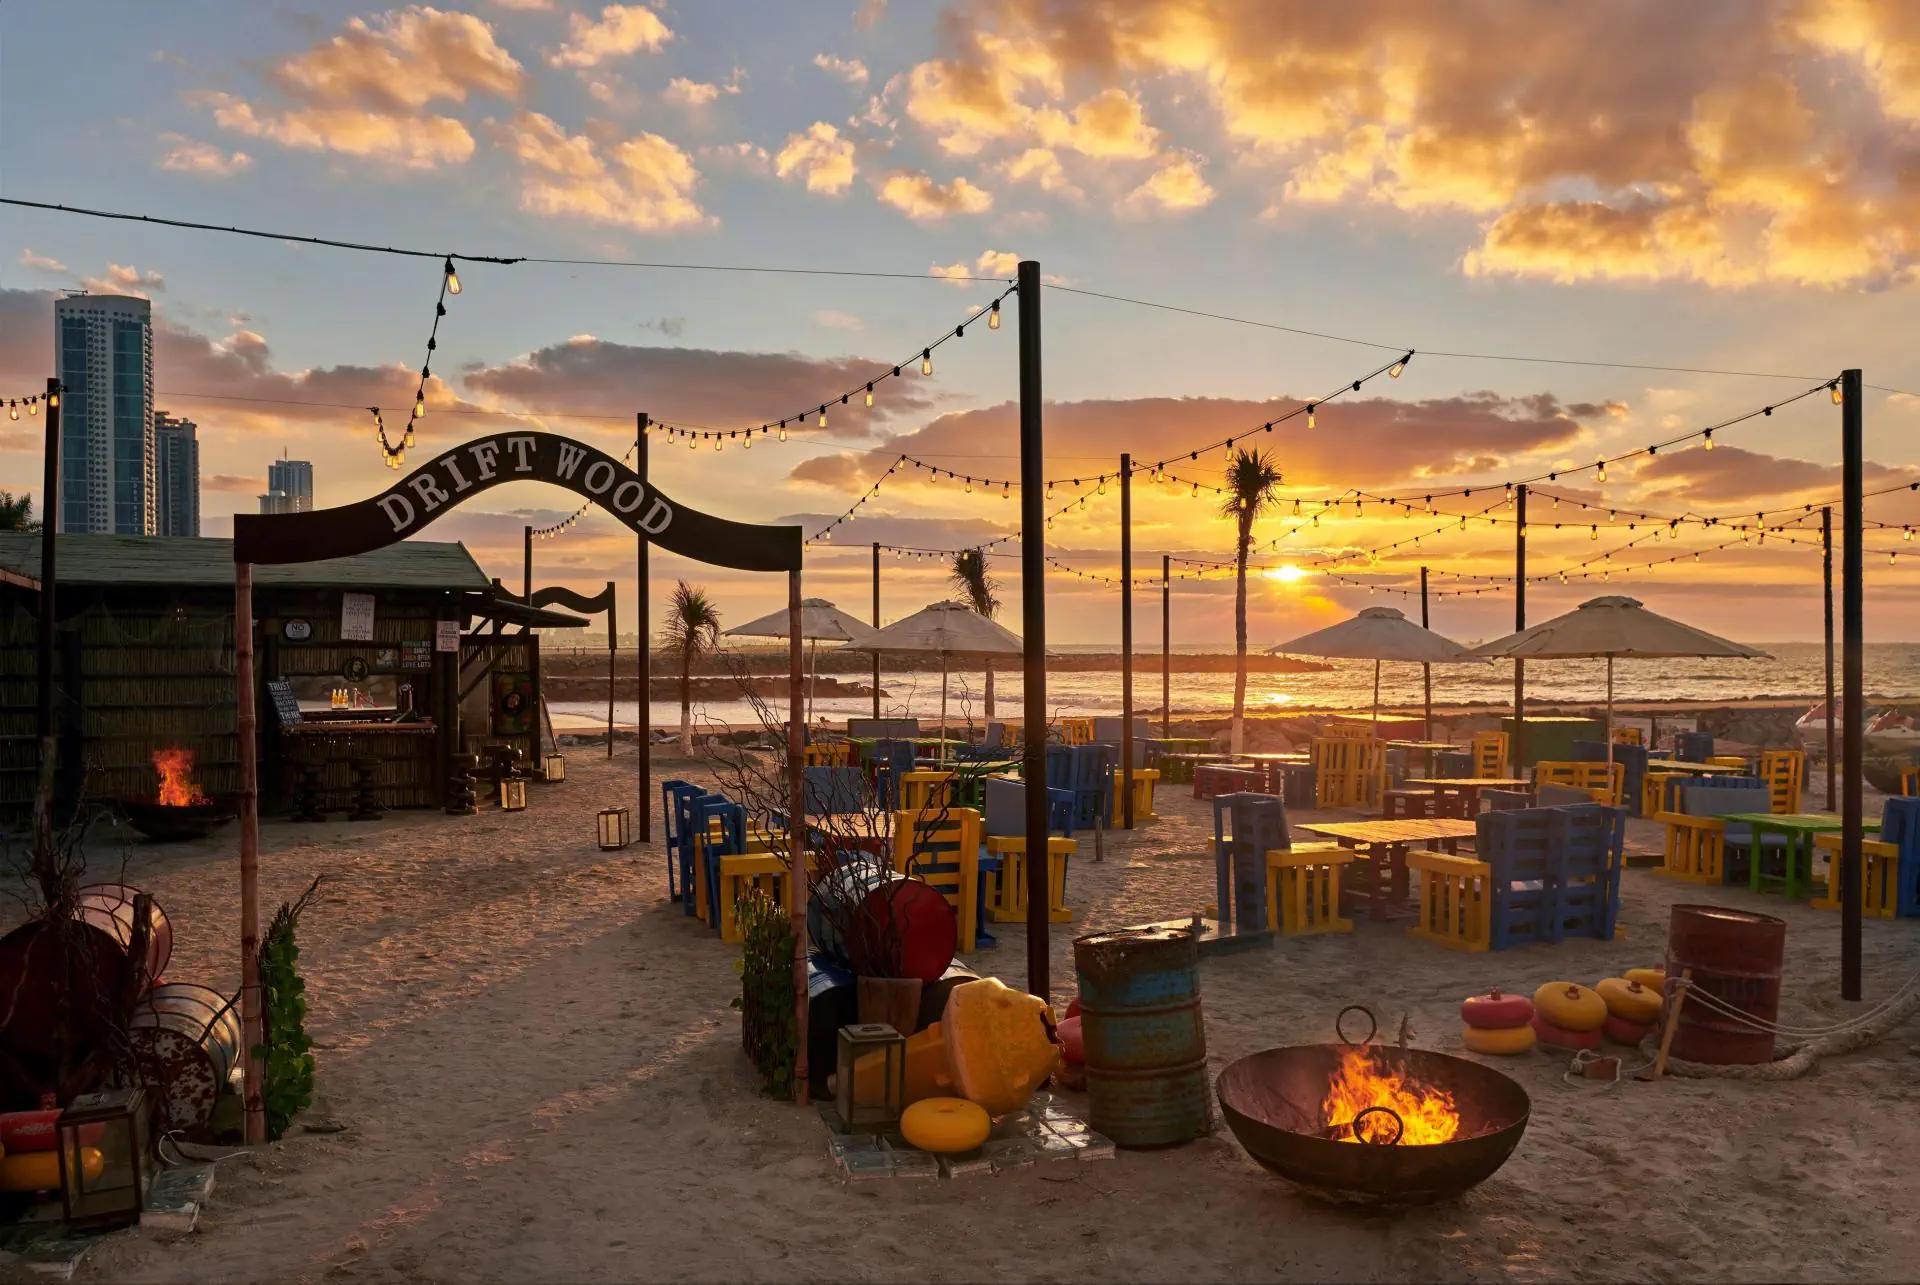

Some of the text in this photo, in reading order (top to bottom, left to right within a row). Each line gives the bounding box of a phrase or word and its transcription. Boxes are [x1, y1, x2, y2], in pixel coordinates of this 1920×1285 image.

[376, 436, 673, 535] DRIFT WOOD
[268, 681, 290, 691] TRUST
